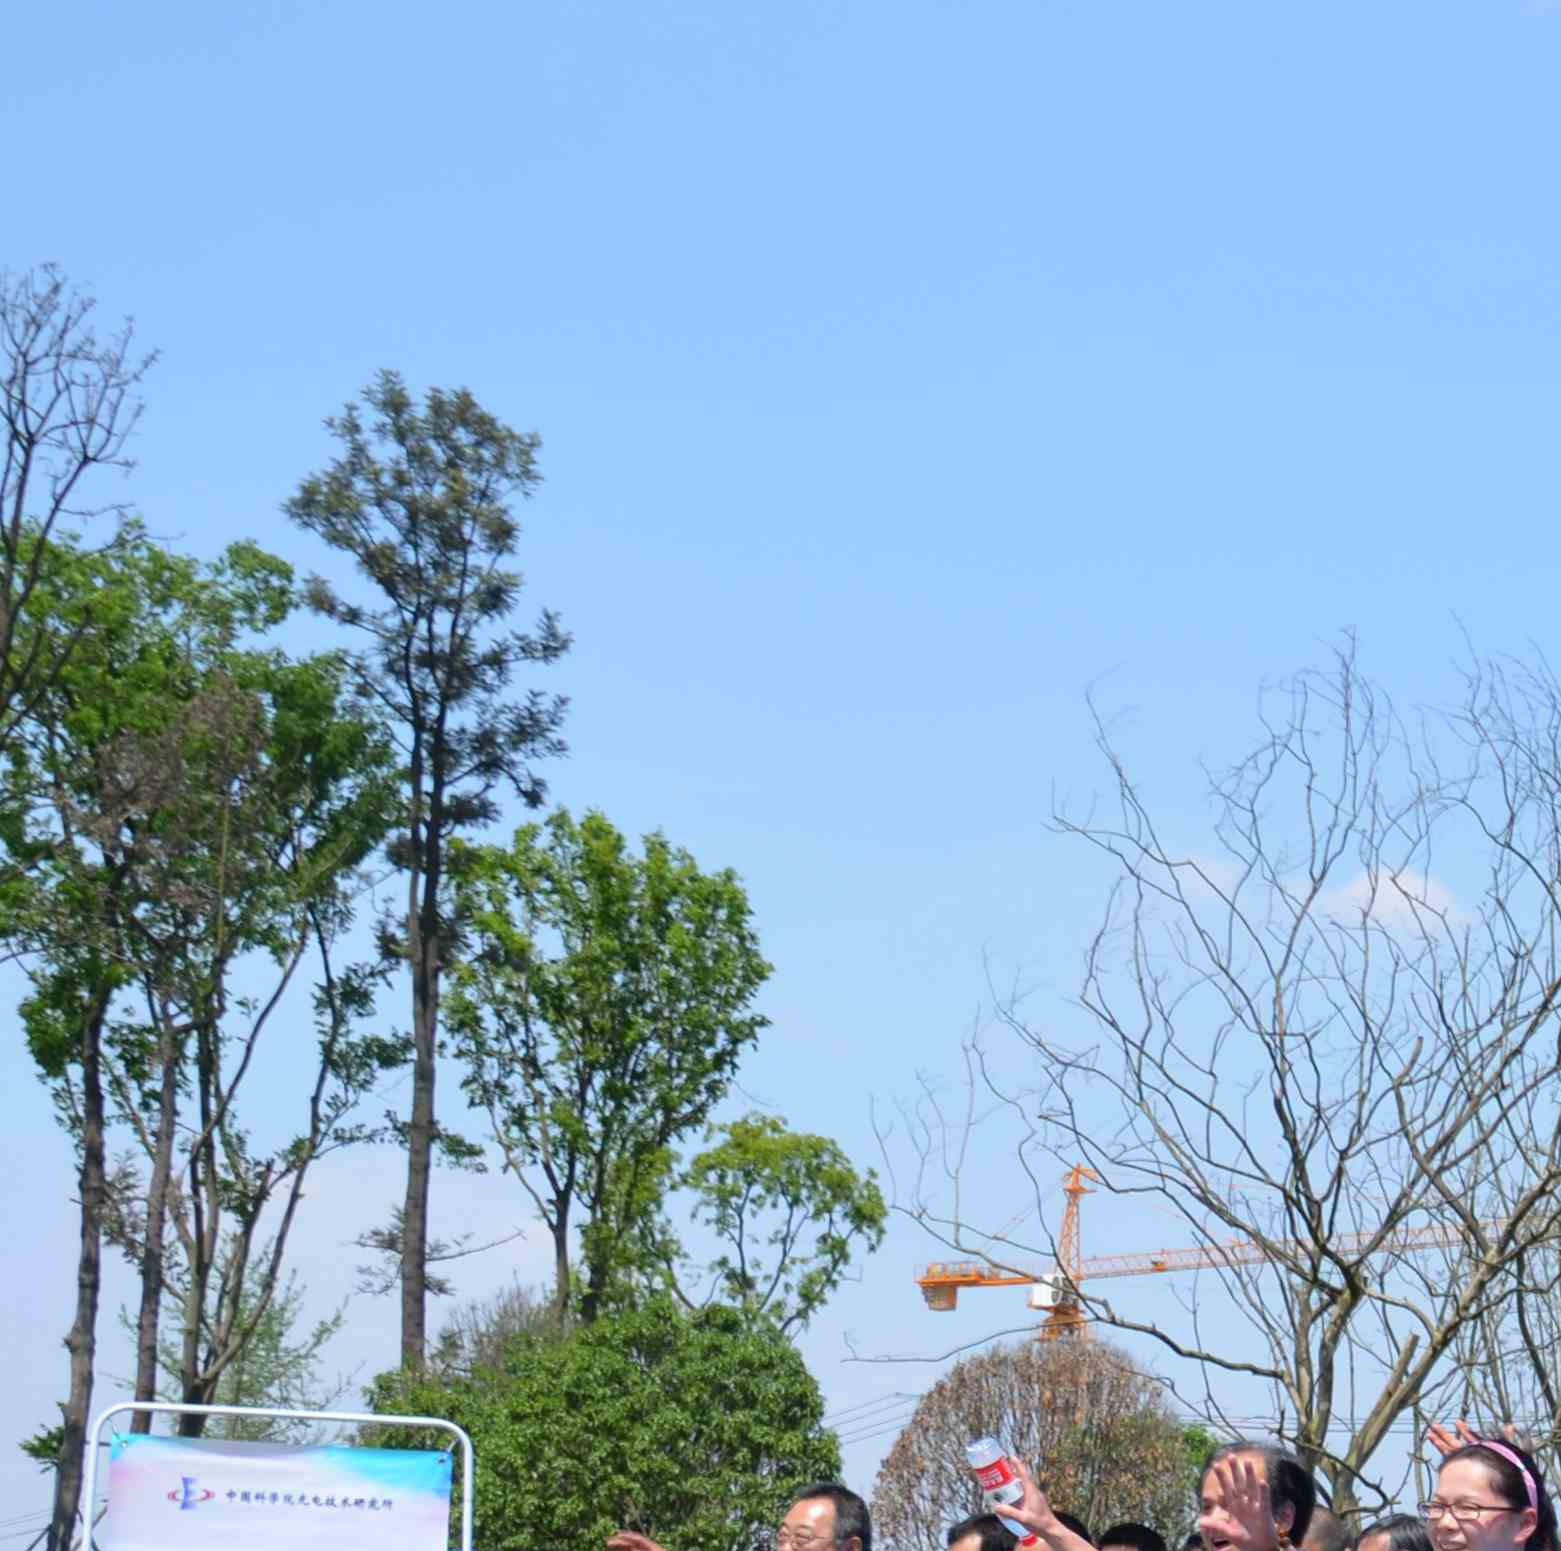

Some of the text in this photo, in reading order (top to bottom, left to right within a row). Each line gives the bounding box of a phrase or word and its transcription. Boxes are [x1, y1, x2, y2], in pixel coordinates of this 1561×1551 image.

[225, 1489, 393, 1511] 中国科学院光电技术研究所
